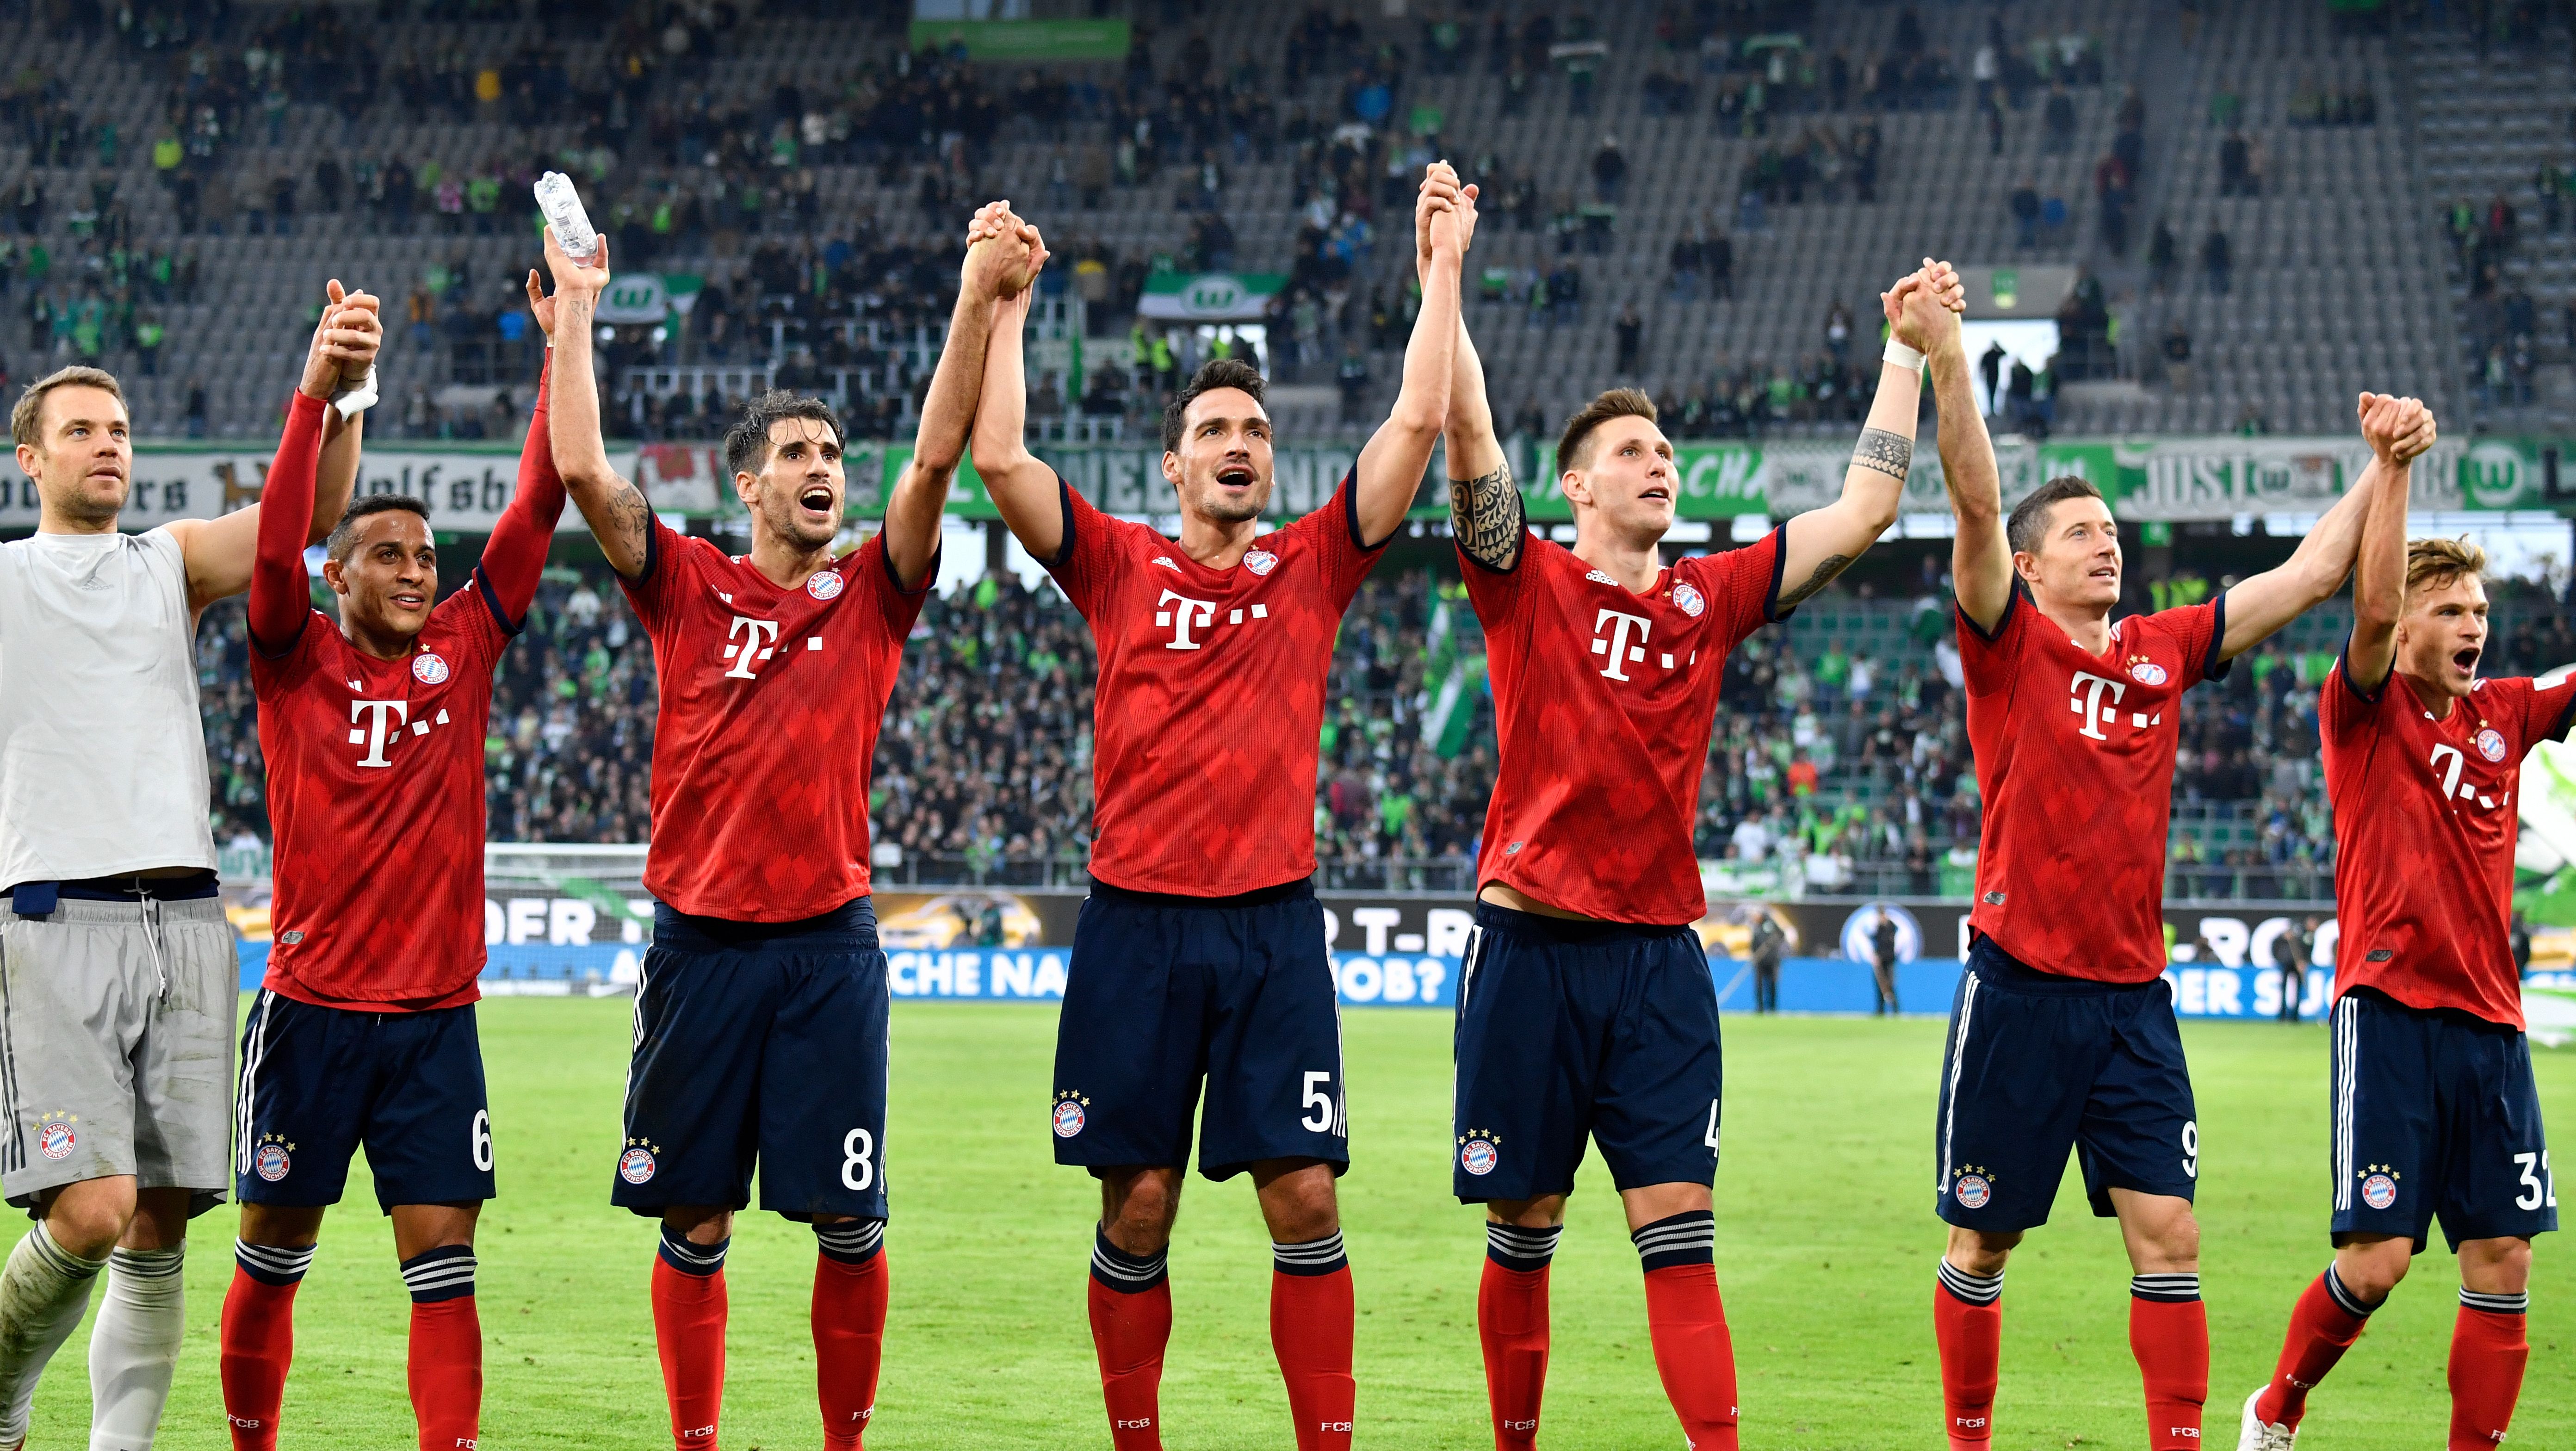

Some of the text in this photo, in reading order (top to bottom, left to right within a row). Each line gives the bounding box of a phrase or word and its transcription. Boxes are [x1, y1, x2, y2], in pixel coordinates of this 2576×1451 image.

[1585, 572, 1619, 587] adidas
[1158, 588, 1216, 649] T
[724, 615, 778, 679] T
[1594, 608, 1652, 682] T
[2071, 670, 2126, 740] T
[351, 700, 408, 767] T
[1352, 907, 1477, 958] T-R
[890, 951, 1067, 996] CHE NA
[1301, 1071, 1333, 1133] 5
[1062, 1104, 1083, 1117] BAYERN
[49, 1124, 73, 1137] BAYERN
[1704, 1098, 1720, 1158] 4
[472, 1109, 494, 1172] 6
[266, 1147, 288, 1162] BAYERN
[1471, 1142, 1494, 1155] BAYERN
[2181, 1121, 2198, 1178] 9
[630, 1151, 652, 1165] BAYERN
[841, 1128, 873, 1191] 8
[1966, 1178, 1988, 1191] BAYERN
[2514, 1149, 2557, 1211] 32
[228, 1414, 259, 1428] FCB
[1118, 1418, 1151, 1429] FCB
[1321, 1422, 1352, 1432] FCB
[1505, 1419, 1536, 1430] FCB
[1957, 1417, 1985, 1428] FCB
[684, 1425, 713, 1438] FCB
[2171, 1427, 2200, 1438] FCB
